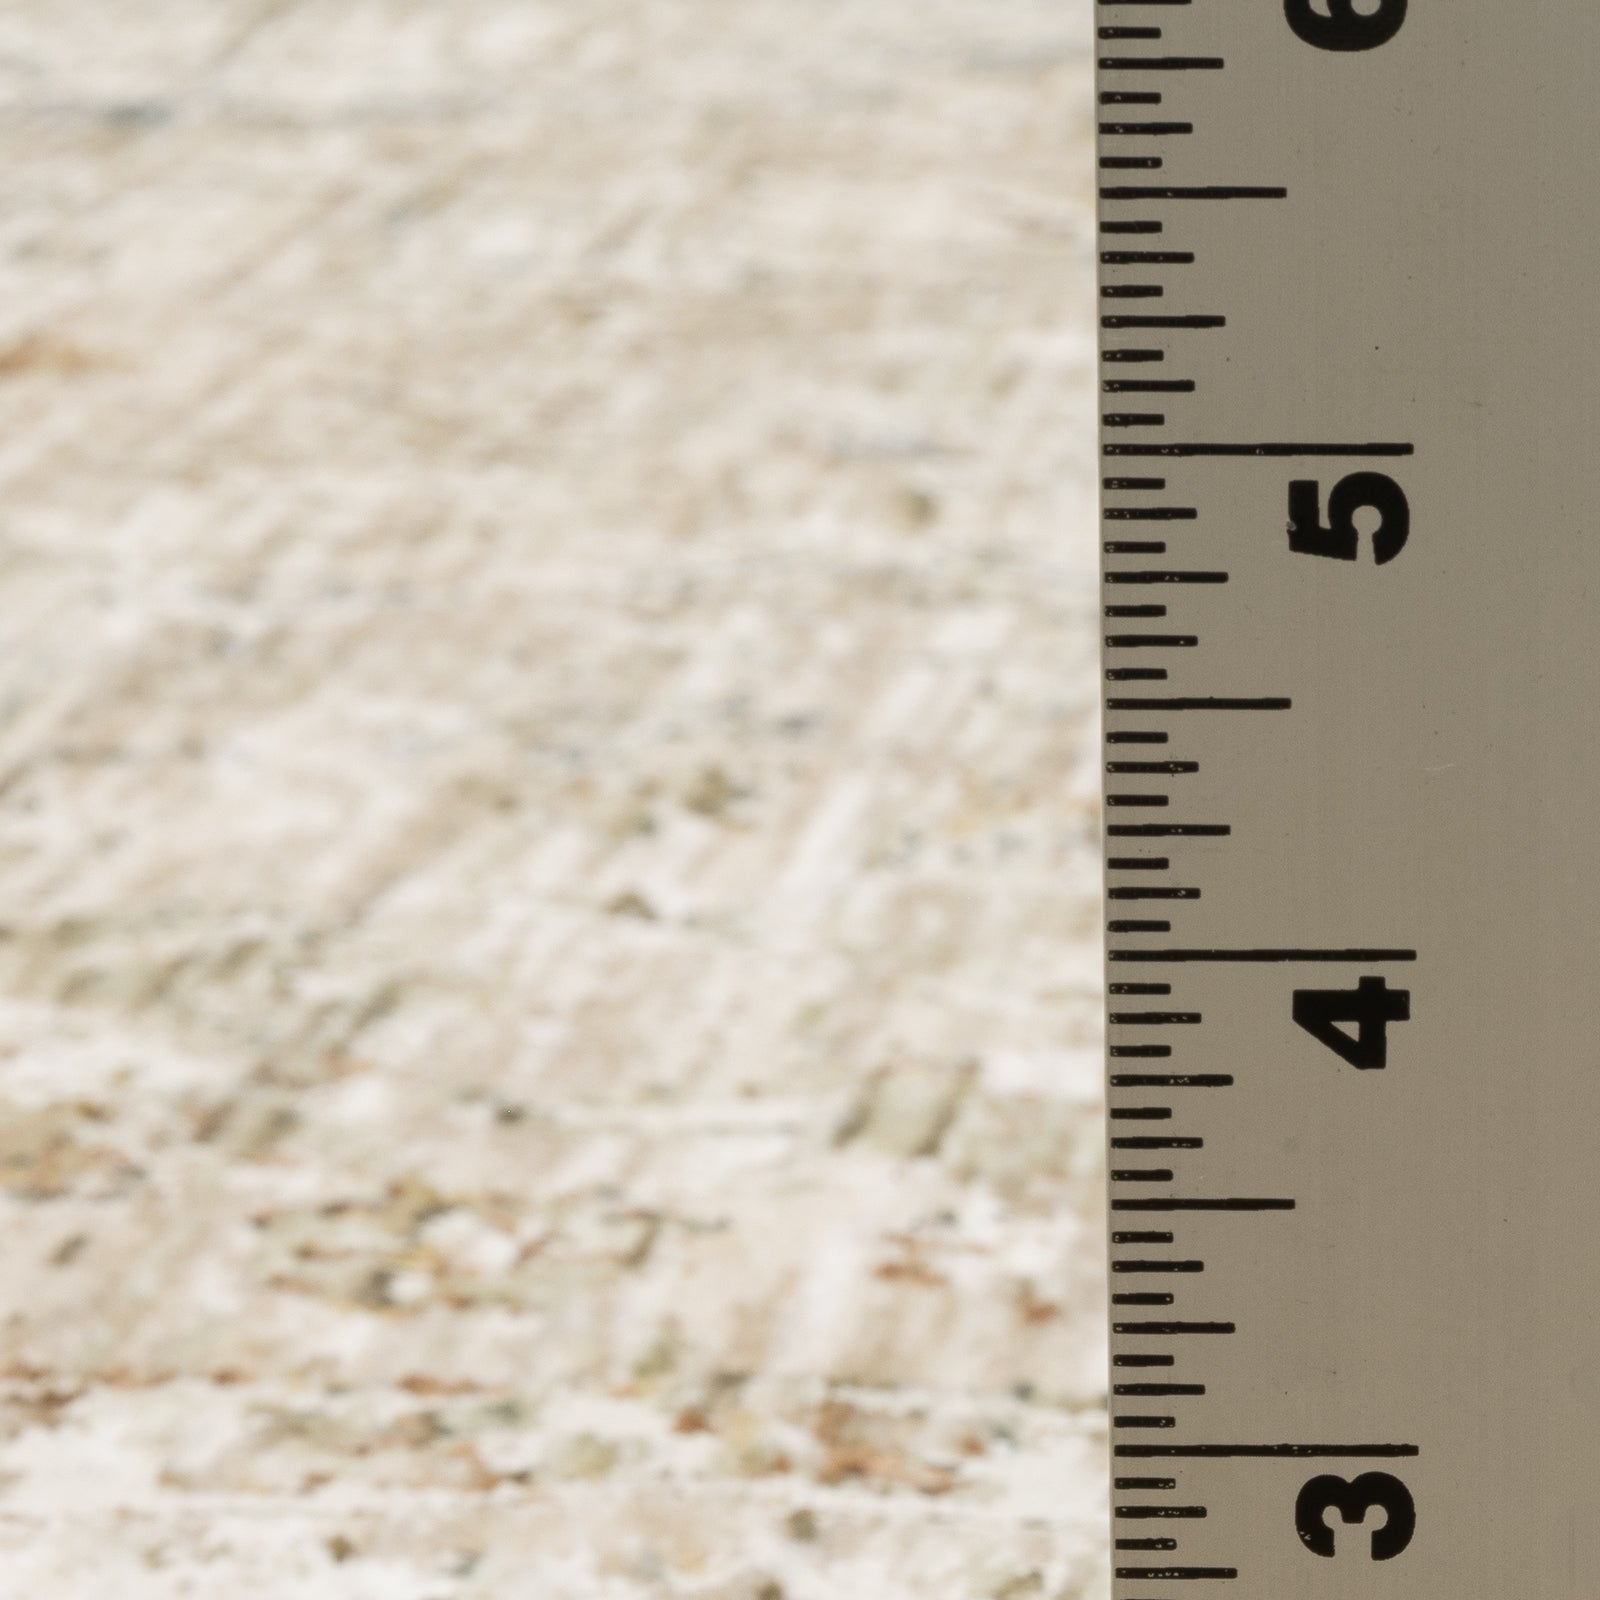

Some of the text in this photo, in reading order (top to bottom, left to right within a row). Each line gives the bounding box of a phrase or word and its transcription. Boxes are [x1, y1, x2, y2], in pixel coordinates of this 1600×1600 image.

[1286, 471, 1410, 566] 5
[1292, 976, 1411, 1071] 4
[1295, 1472, 1416, 1562] 3
